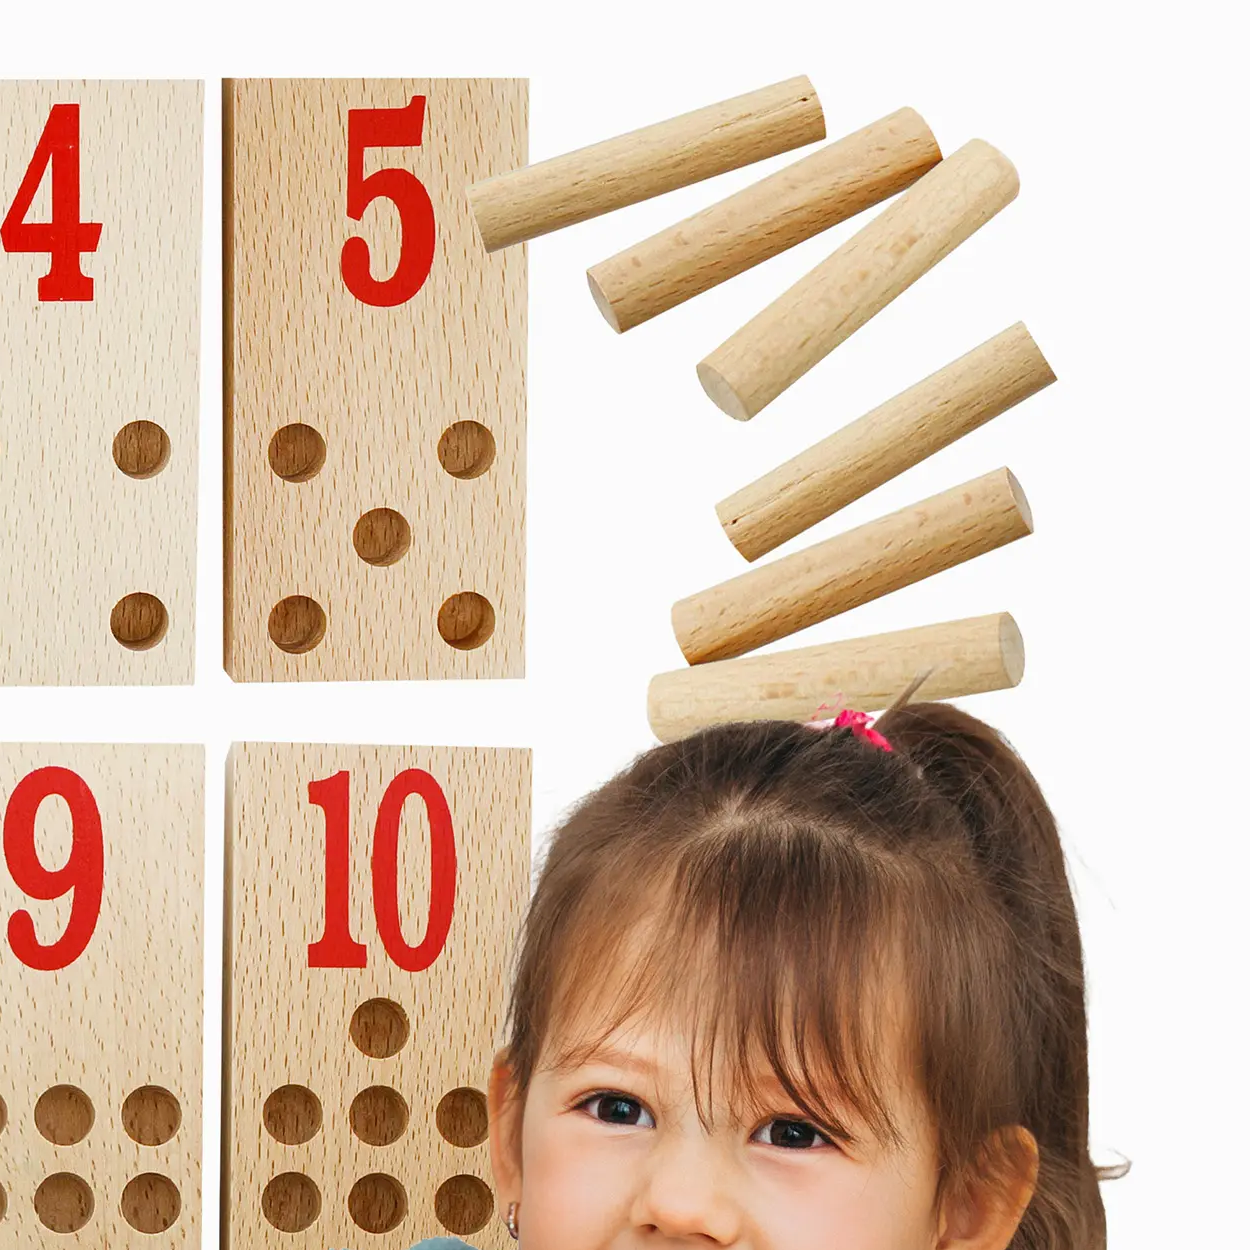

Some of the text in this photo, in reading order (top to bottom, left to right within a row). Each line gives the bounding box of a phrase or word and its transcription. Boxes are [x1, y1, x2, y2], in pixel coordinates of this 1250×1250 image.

[0, 104, 102, 301] 4
[341, 96, 435, 307] 5
[4, 767, 103, 971] 9
[308, 769, 457, 972] 10
